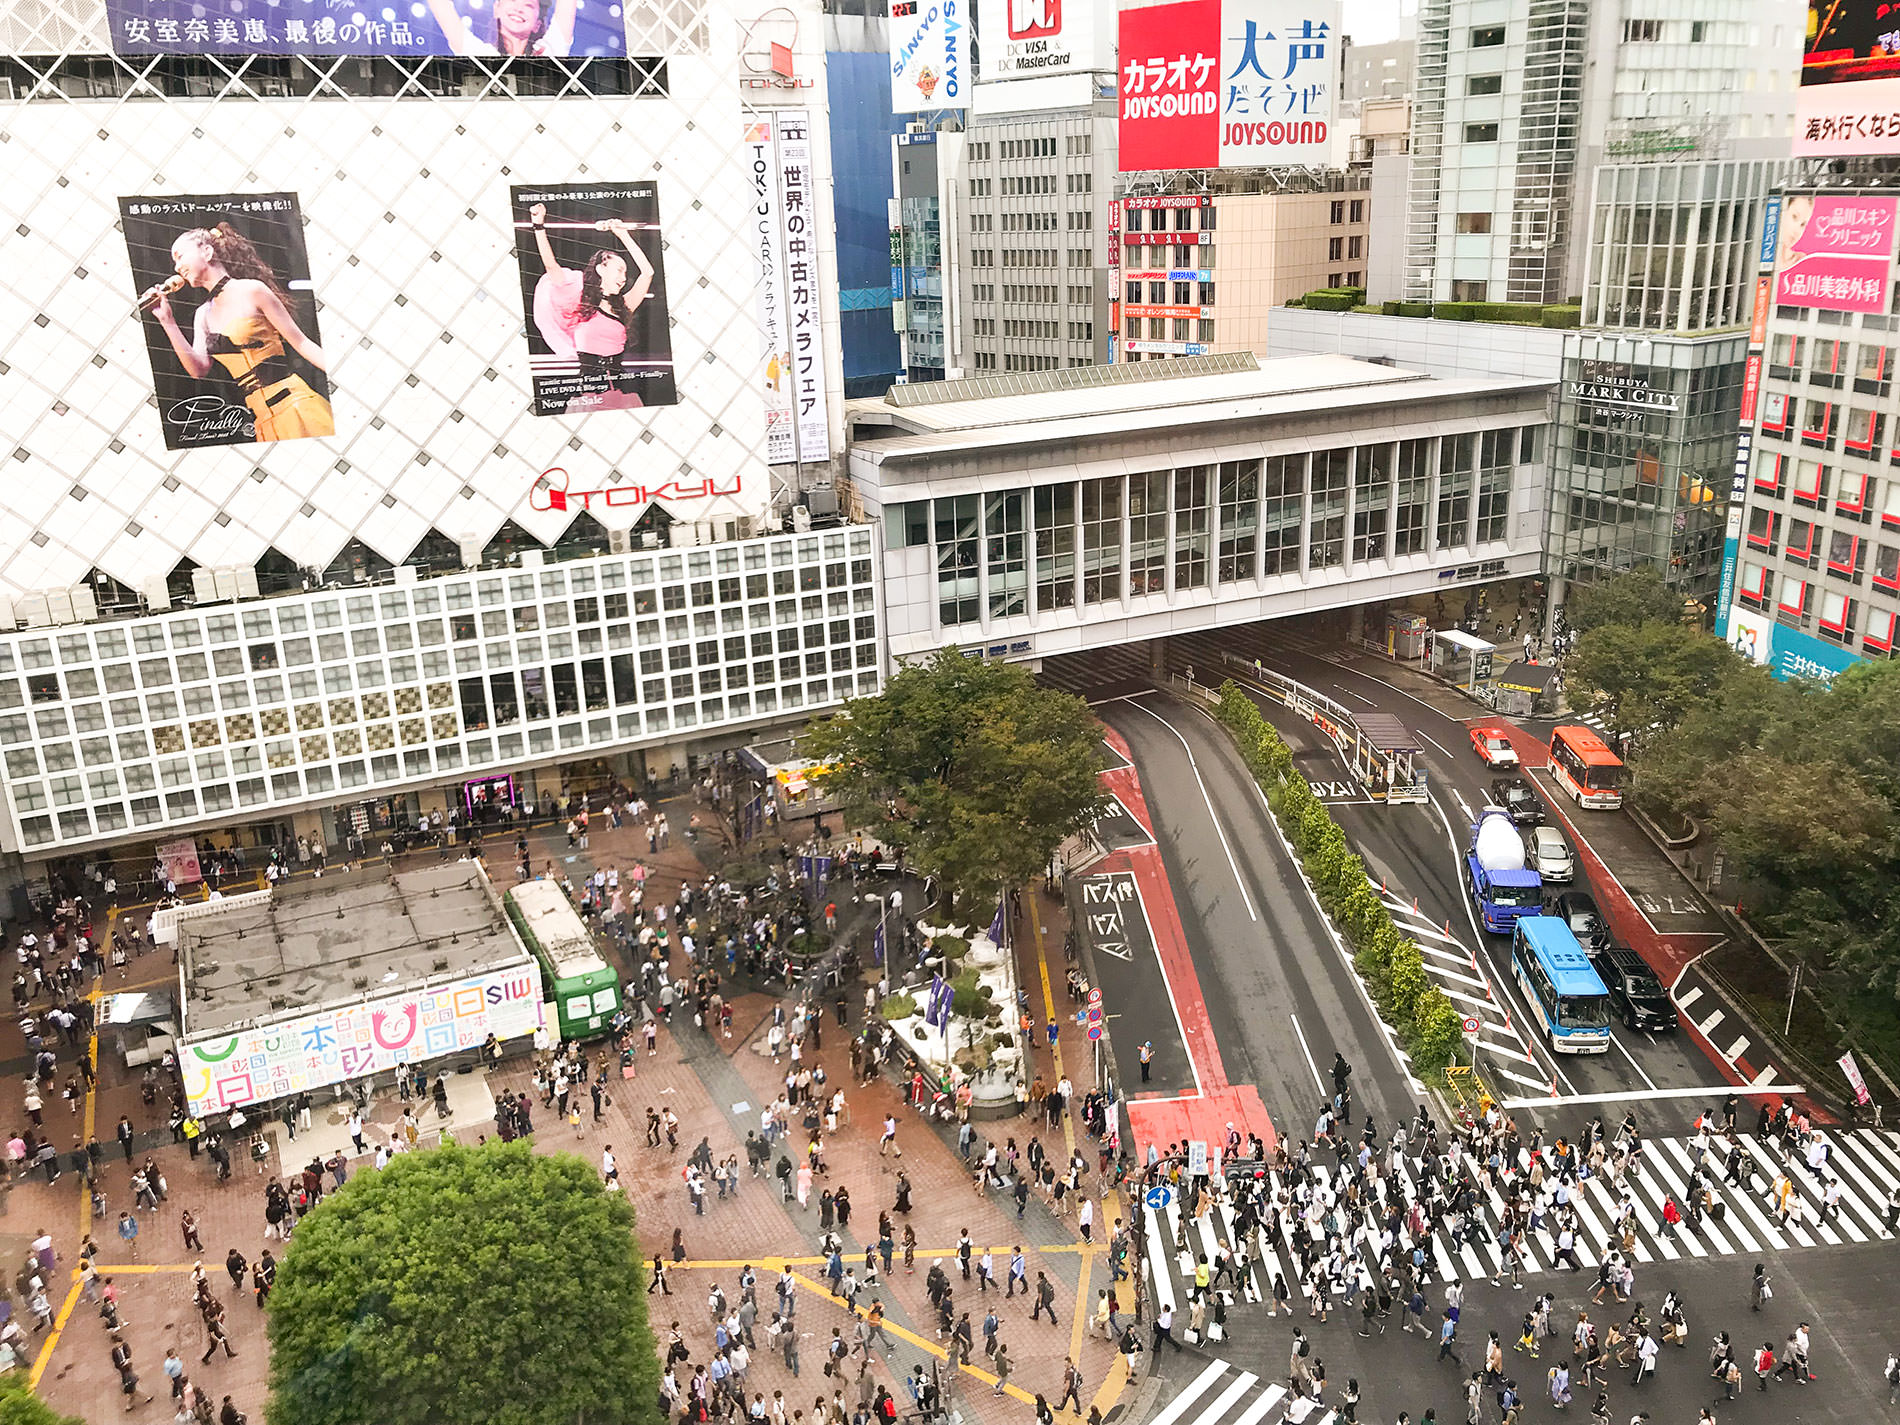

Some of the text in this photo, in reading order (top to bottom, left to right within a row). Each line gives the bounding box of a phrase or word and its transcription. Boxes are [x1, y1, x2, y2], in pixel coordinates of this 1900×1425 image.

[124, 17, 426, 46] 安室奈美恵、最後の作品。
[893, 6, 938, 78] SANKYO
[943, 0, 962, 98] SANKYO
[1015, 52, 1071, 70] MasterCard
[1025, 40, 1048, 54] VISA
[1226, 19, 1331, 81] 大声
[1123, 52, 1217, 95] カラオケ
[1122, 91, 1217, 120] JOYSOUND
[1223, 120, 1327, 147] JOYSOUND
[1128, 198, 1158, 209] カラオケ
[1159, 196, 1197, 207] JOYSOUND
[1829, 207, 1891, 227] 品川スキン
[1828, 228, 1882, 248] クリニック
[784, 165, 816, 417] 世界の中古カメラフェア
[1791, 274, 1881, 303] 品川美容外科
[1570, 382, 1680, 406] MARK CITY
[1596, 375, 1649, 388] SHIBUYA
[541, 395, 603, 409] Now on Sale
[567, 476, 742, 510] TOKYU
